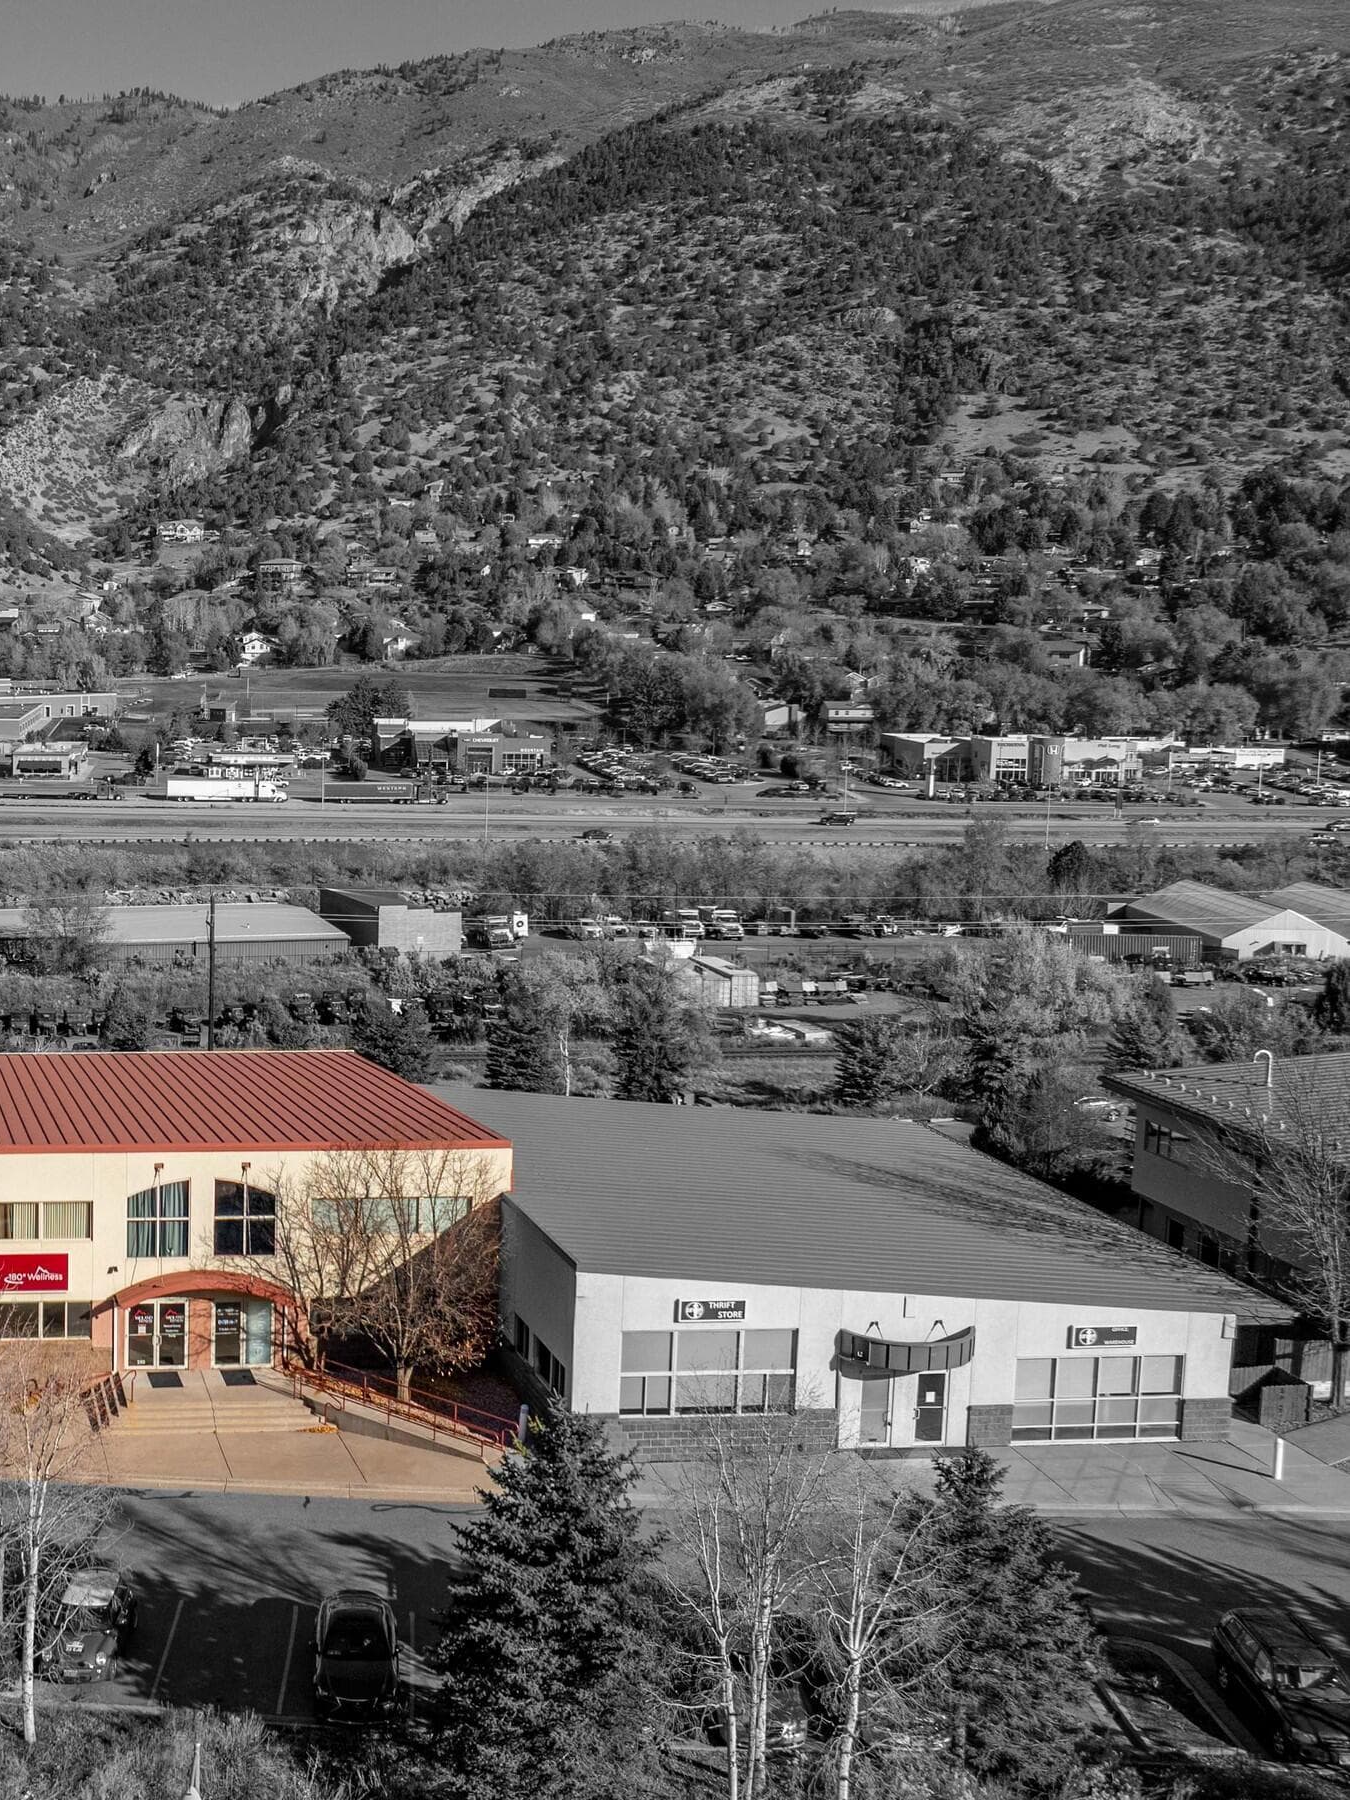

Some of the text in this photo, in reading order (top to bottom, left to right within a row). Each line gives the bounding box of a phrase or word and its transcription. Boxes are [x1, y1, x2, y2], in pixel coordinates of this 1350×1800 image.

[27, 1272, 63, 1281] Wellness
[709, 1301, 736, 1309] THRIFT
[717, 1310, 743, 1319] STORE
